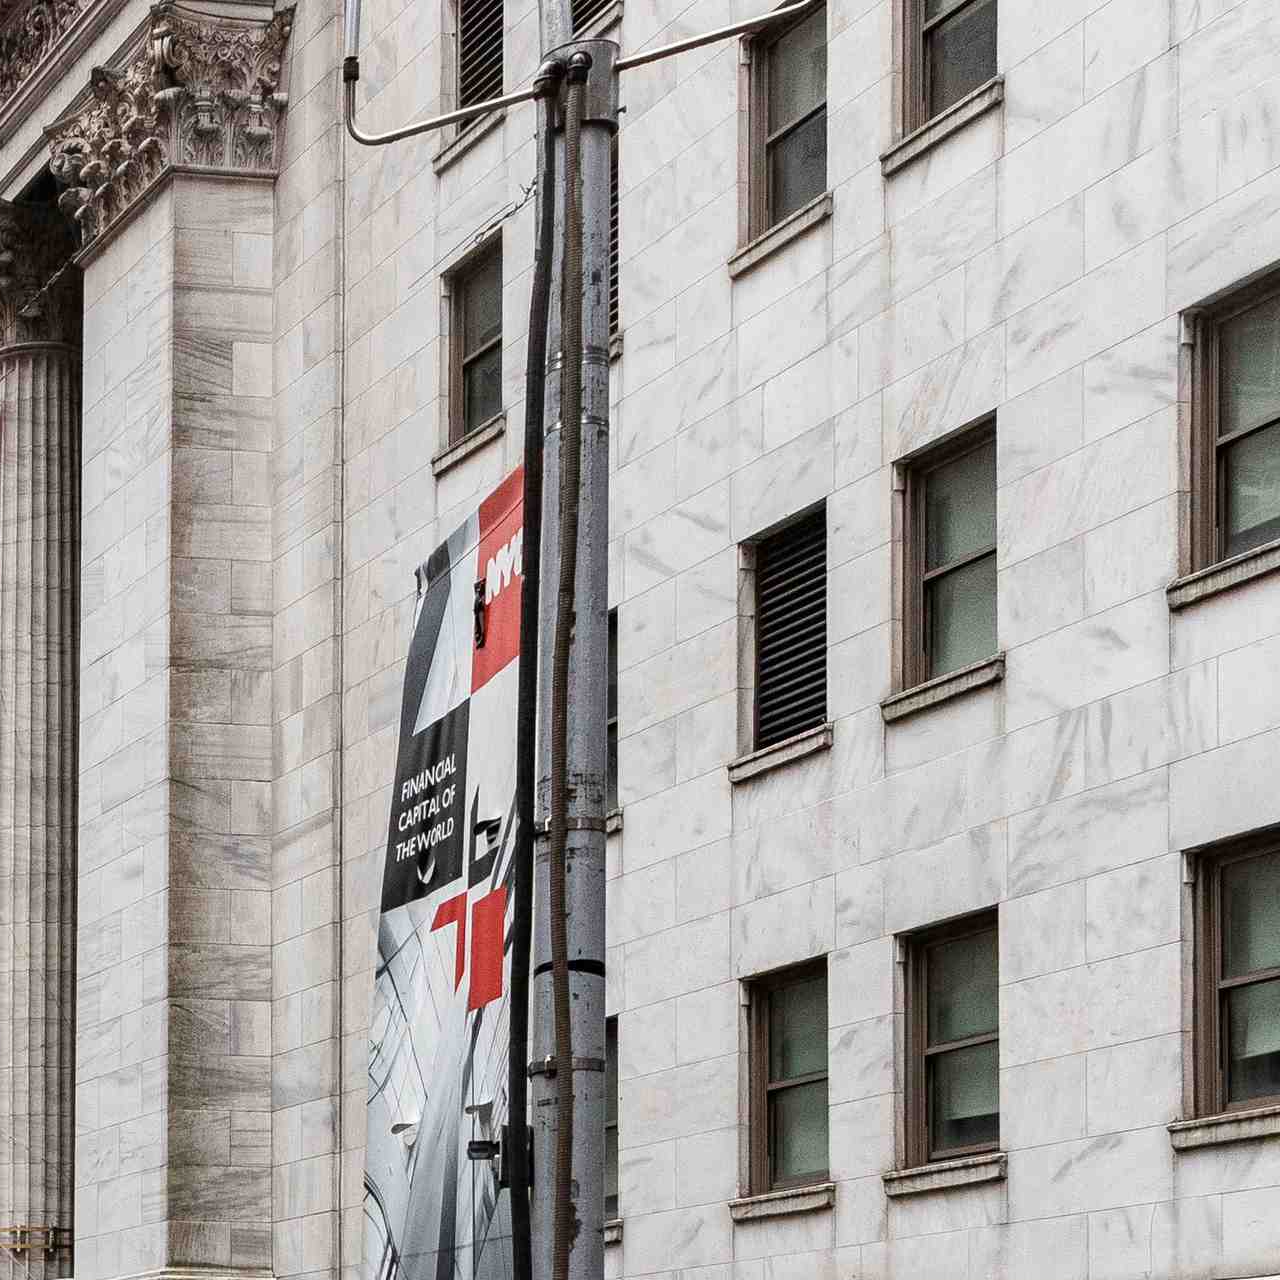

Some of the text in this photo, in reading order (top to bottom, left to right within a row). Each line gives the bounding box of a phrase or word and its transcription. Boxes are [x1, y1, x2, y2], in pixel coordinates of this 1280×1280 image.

[401, 752, 456, 802] FINANCIAL
[398, 784, 456, 832] CAPITAL OF
[396, 816, 454, 862] THE WORLD
